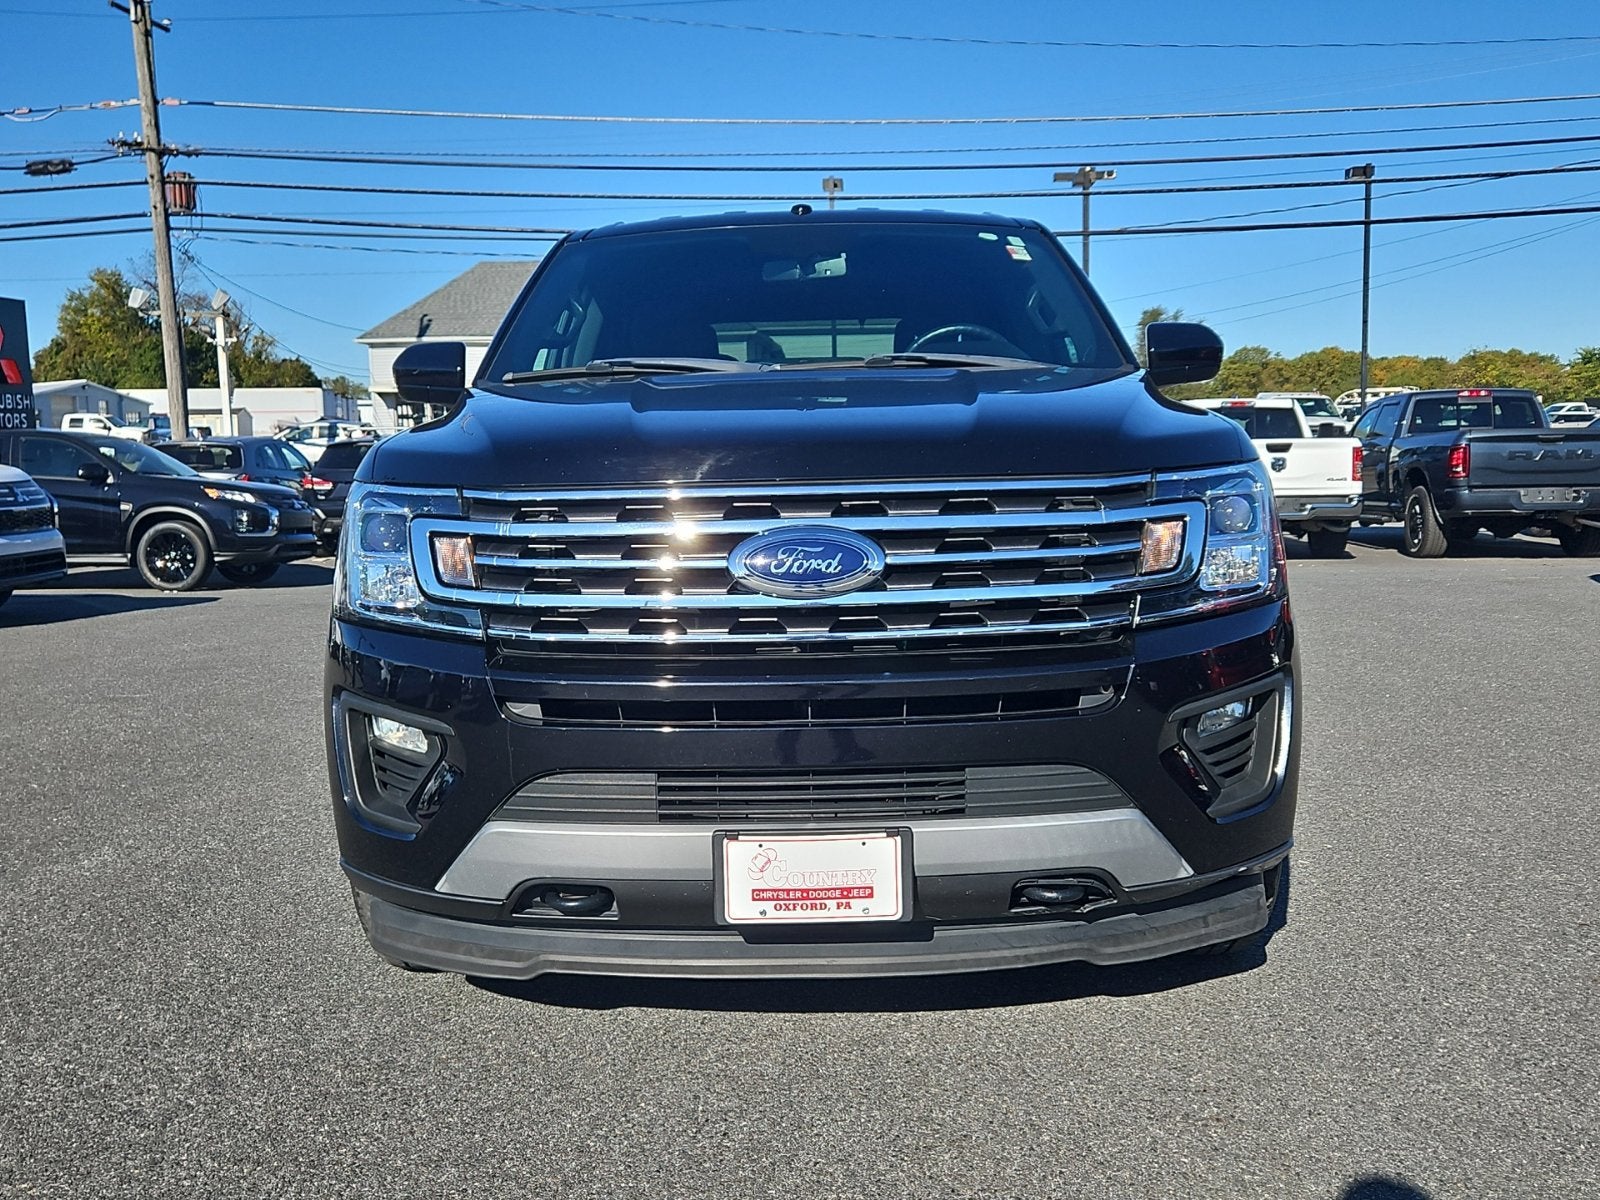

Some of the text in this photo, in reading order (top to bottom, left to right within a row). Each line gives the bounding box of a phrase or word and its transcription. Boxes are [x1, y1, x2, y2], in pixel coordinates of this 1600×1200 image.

[1507, 448, 1594, 461] RAM
[770, 545, 843, 575] Ford
[753, 888, 872, 899] CHRYSLER DODGE JEEP
[773, 901, 853, 912] OXFORD, PA
